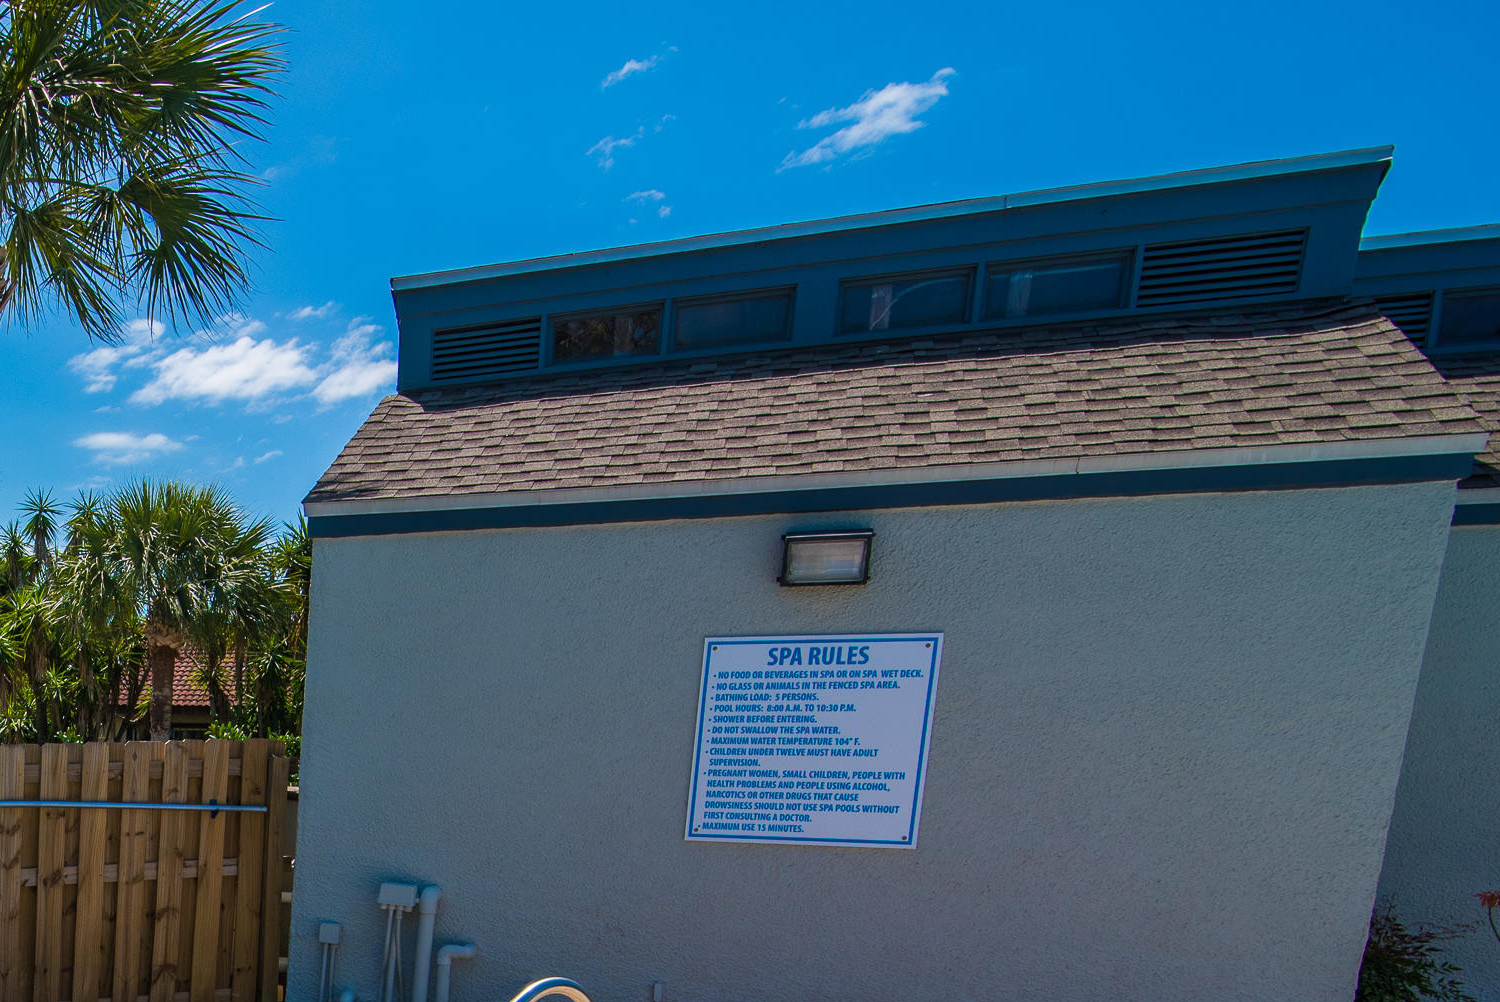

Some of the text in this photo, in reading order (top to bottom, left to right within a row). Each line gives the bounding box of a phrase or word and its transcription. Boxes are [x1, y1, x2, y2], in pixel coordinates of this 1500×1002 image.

[767, 646, 870, 666] SPA RULES
[731, 671, 751, 679] FOOD
[752, 671, 763, 679] OR
[810, 670, 819, 678] IN
[820, 670, 834, 678] SPA
[836, 670, 847, 678] OR
[849, 670, 861, 678] ON
[862, 670, 877, 678] SPA
[900, 669, 924, 677] DECK.
[753, 682, 764, 690] OR
[765, 682, 800, 690] ANIMALS
[828, 681, 858, 689] FENCED
[860, 681, 875, 689] SPA
[750, 693, 772, 701] LOAD:
[767, 704, 784, 712] 8:00
[785, 704, 802, 712] A.M.
[805, 704, 814, 712] TO
[817, 704, 839, 712] 10:30
[840, 704, 856, 712] P.M.
[713, 715, 817, 723] SHOWER BEFORE ENTERING.
[741, 726, 778, 734] SWALLOW
[780, 726, 794, 734] THE
[796, 726, 810, 734] SPA
[812, 726, 841, 734] WATER.
[711, 737, 749, 745] MAXIMUM
[751, 737, 776, 745] WATER
[778, 737, 833, 745] TEMPERATURE
[748, 748, 774, 756] UNDER
[776, 748, 808, 756] TWELVE
[807, 749, 829, 757] MUST
[831, 749, 851, 757] HAVE
[853, 749, 879, 757] ADULT
[708, 769, 748, 777] PREGNANT
[749, 770, 780, 779] WOMEN,
[782, 770, 807, 778] SMALL
[809, 771, 850, 780] CHILDREN,
[852, 771, 883, 779] PEOPLE
[827, 782, 851, 790] USING
[852, 783, 890, 792] ALCOHOL,
[747, 791, 758, 799] OR
[786, 792, 811, 800] DRUGS
[834, 793, 859, 801] CAUSE
[705, 801, 900, 813] DROWSINESS SHOULD NOT USE SPA POOLS WITHOUT
[725, 812, 771, 821] CONSULTING
[772, 813, 777, 821] A
[779, 814, 812, 822] DOCTOR.
[702, 822, 740, 830] MAXIMUM
[768, 824, 804, 833] MINUTES.
